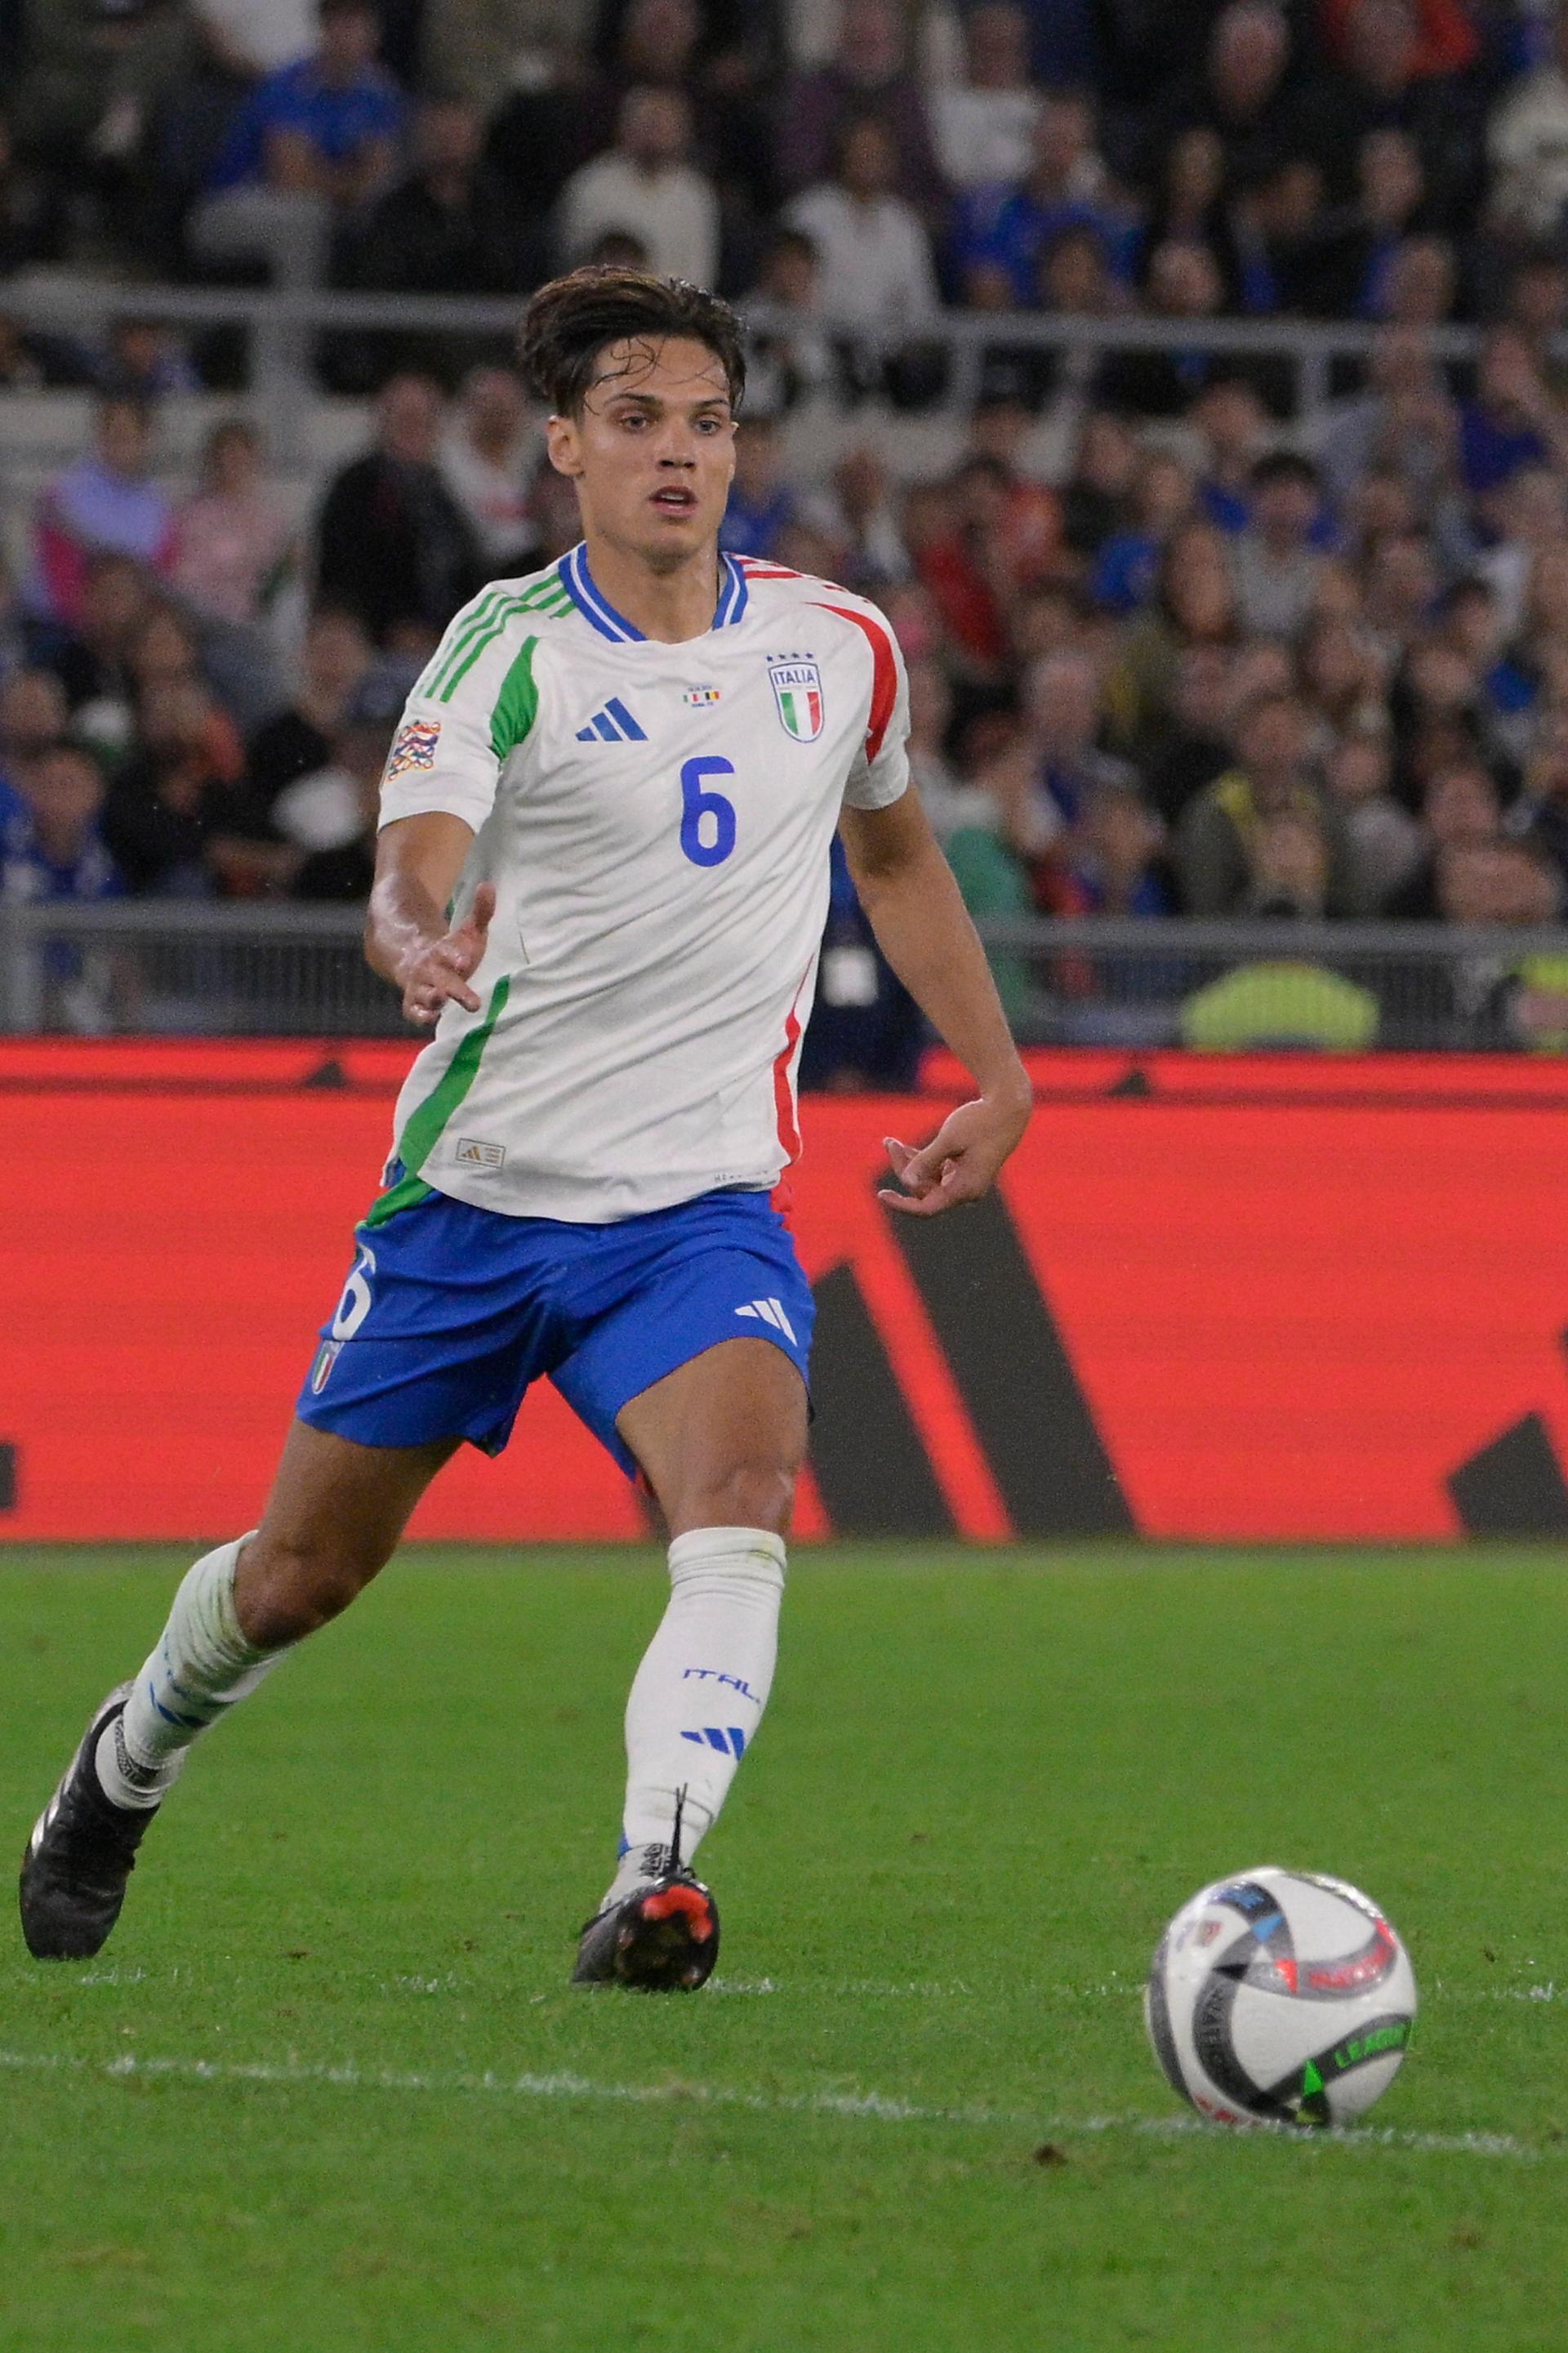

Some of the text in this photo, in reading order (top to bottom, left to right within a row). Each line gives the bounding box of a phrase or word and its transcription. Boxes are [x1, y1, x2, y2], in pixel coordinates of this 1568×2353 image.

[773, 669, 815, 684] ITALIA
[679, 755, 737, 867] 6
[332, 1242, 376, 1341] 6
